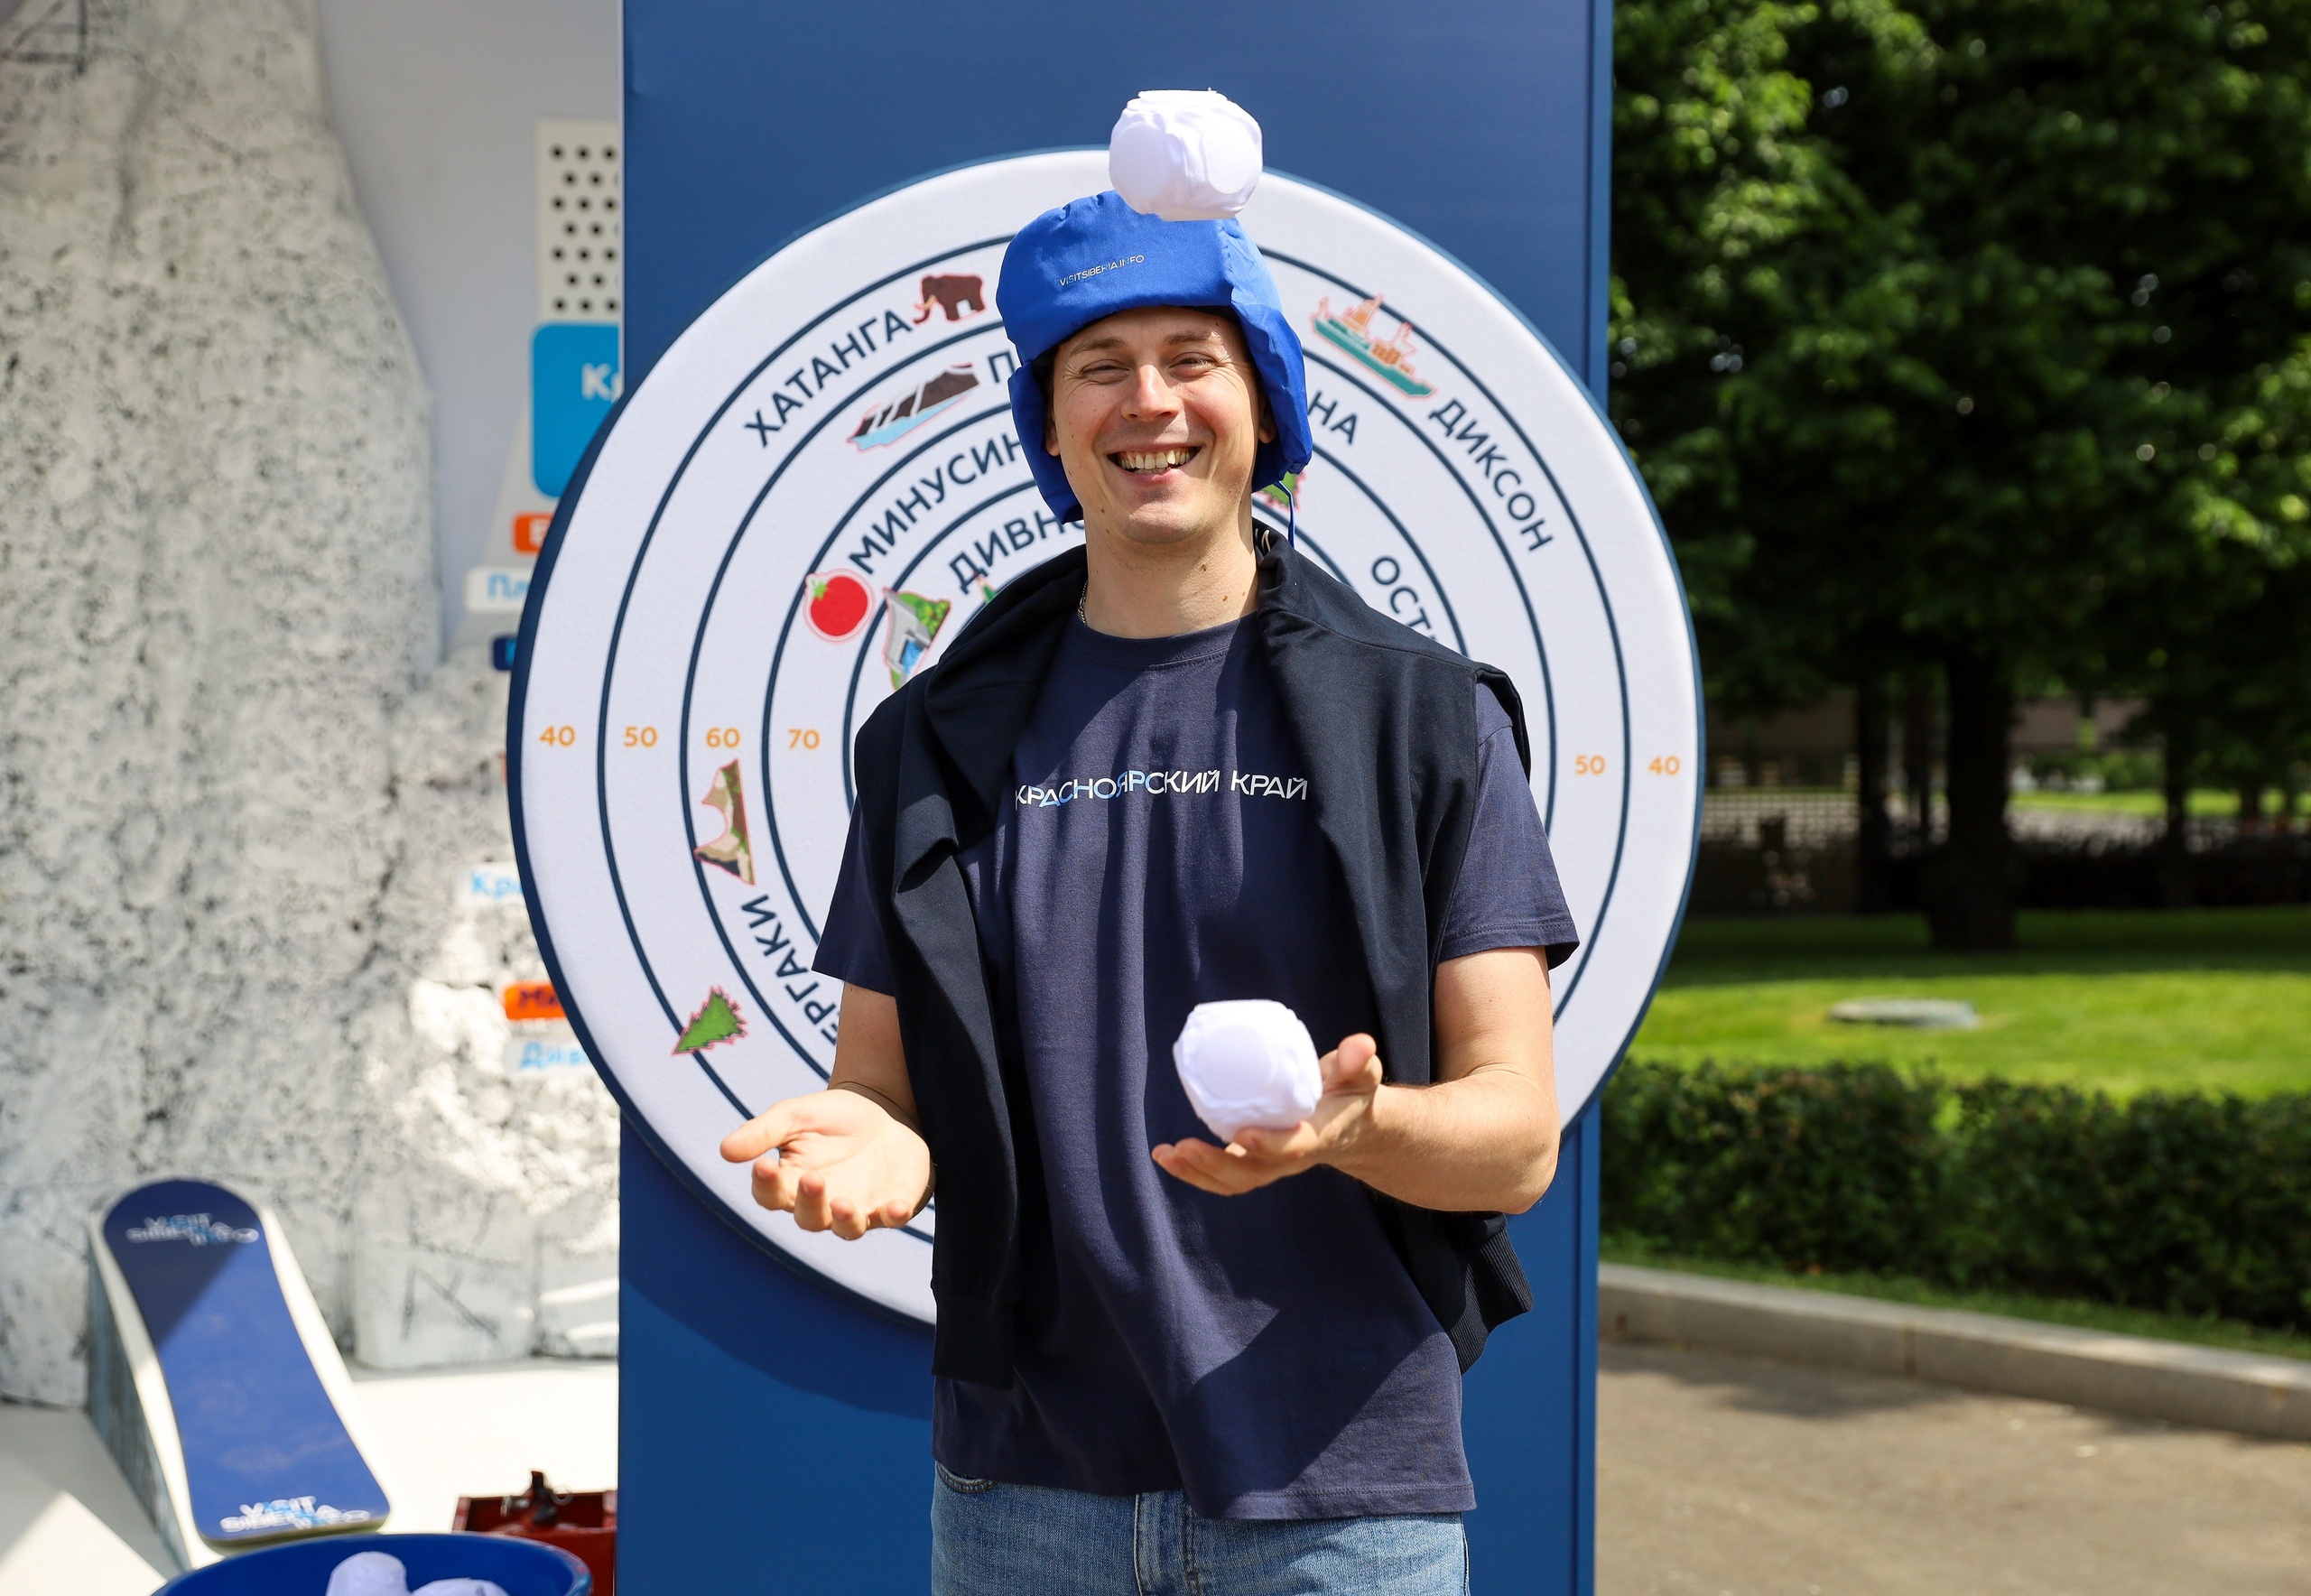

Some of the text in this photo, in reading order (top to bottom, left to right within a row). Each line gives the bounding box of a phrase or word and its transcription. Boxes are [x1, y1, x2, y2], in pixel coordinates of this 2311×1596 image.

[1059, 255, 1145, 286] VISITSIBERIA.INFO
[743, 309, 914, 448] ХАТАНГА
[1428, 397, 1555, 552] ДИКСОН
[1370, 555, 1437, 642] ОСТ
[539, 725, 576, 747] 40
[623, 725, 658, 747] 50
[705, 727, 740, 748] 60
[787, 728, 821, 750] 70
[1574, 754, 1606, 775] 50
[1648, 755, 1681, 775] 40
[1015, 769, 1309, 810] КРАСНОЯРСКИЙ КРАЙ
